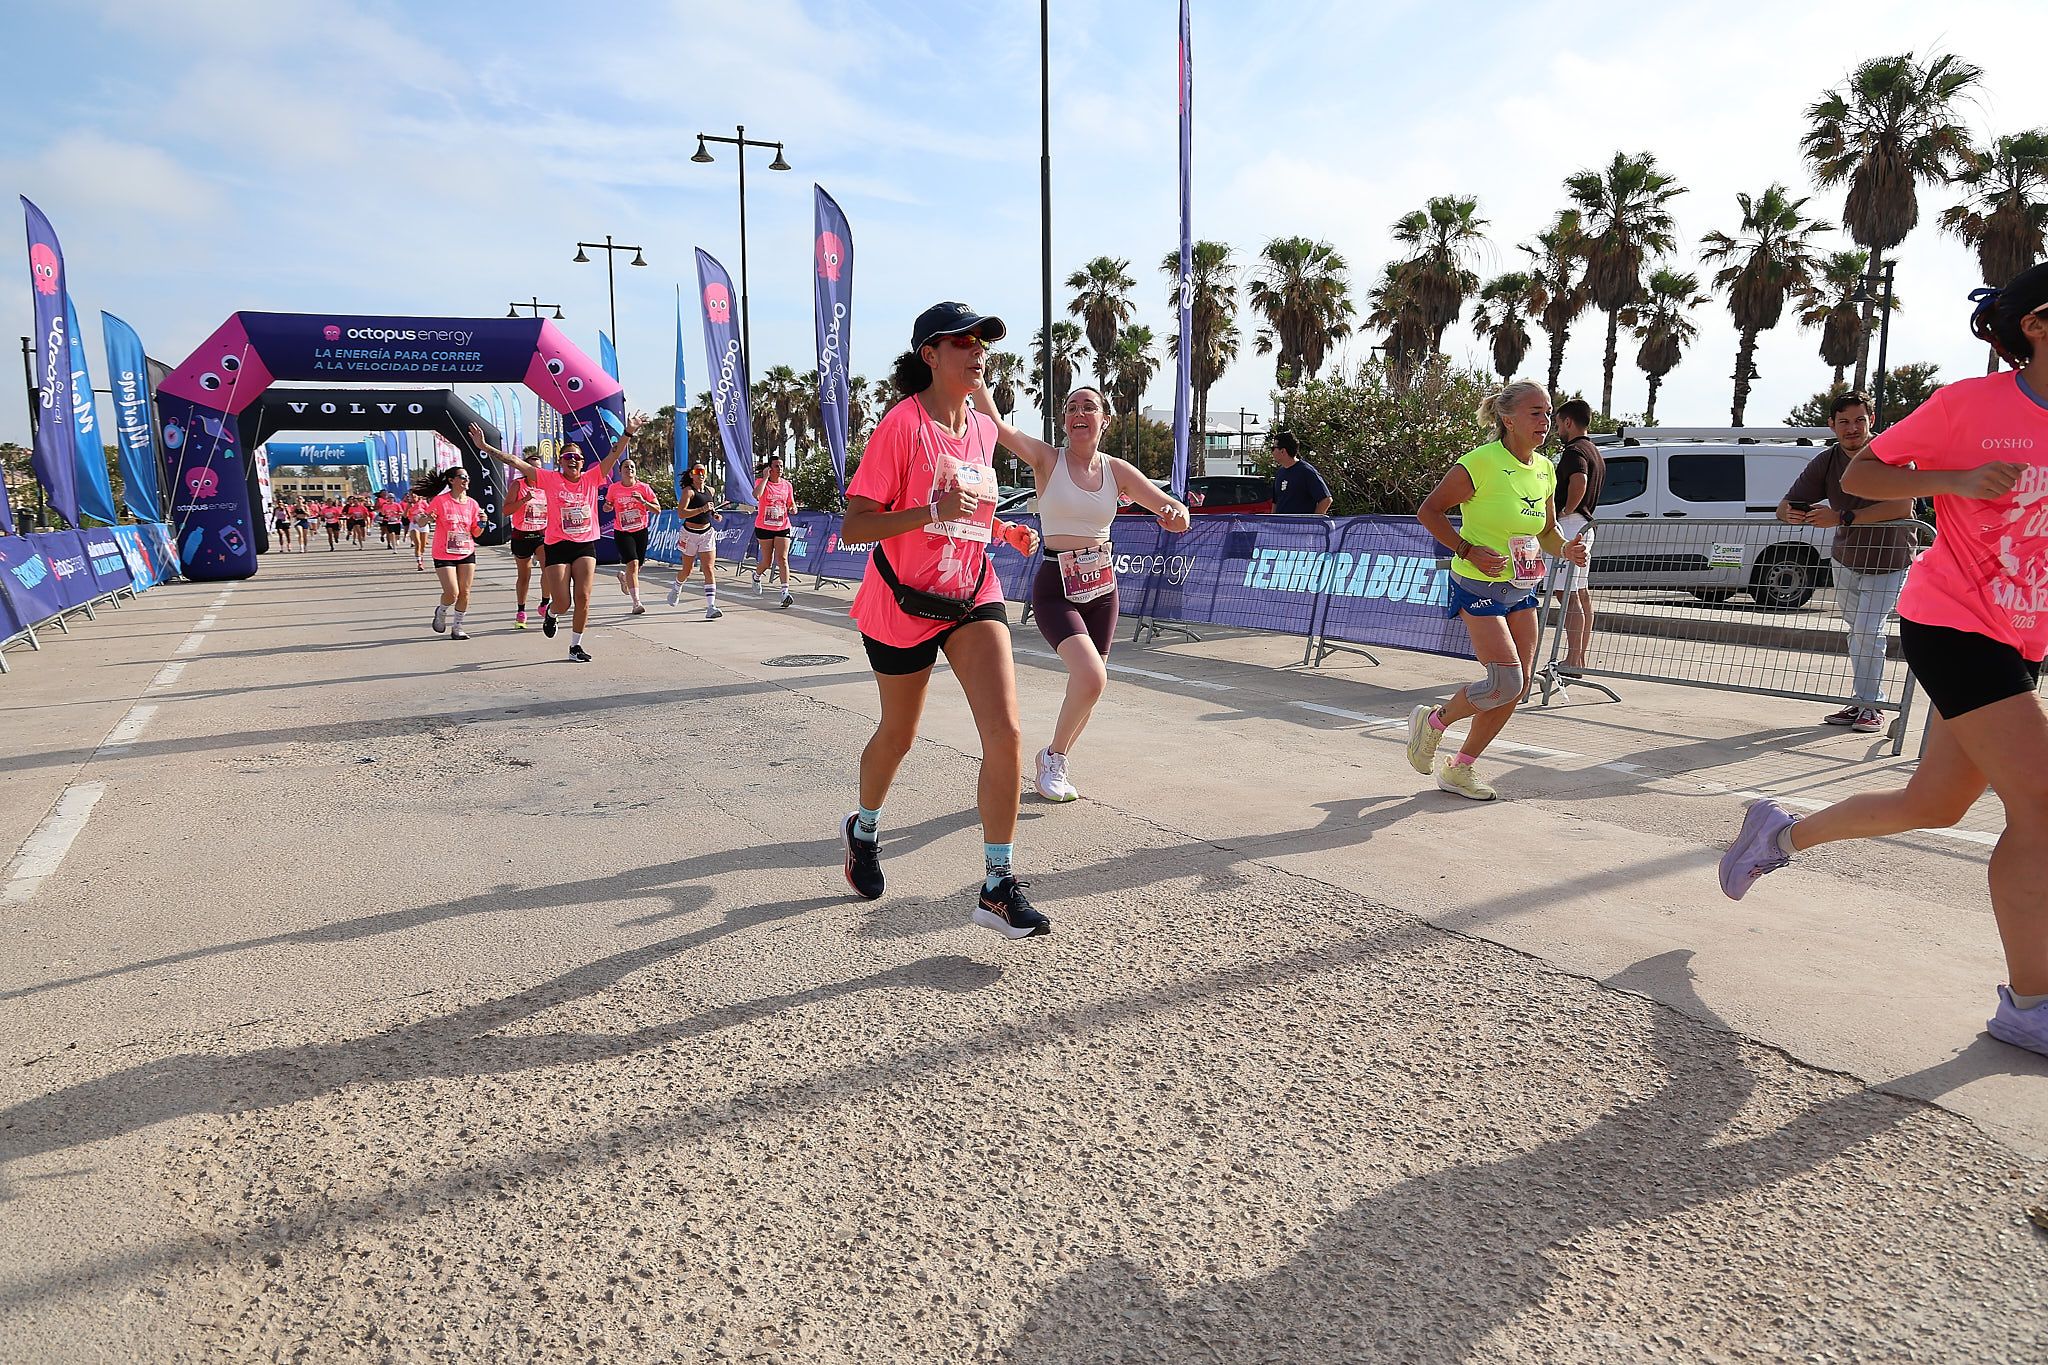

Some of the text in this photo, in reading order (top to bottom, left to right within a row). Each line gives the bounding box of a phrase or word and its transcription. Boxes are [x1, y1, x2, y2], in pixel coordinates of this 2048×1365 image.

[347, 327, 473, 346] octopus energy
[314, 348, 481, 361] LA ENERGÍA PARA CORRER
[314, 361, 484, 372] A LA VELOCIDAD DE LA LUZ
[287, 402, 423, 414] VOLVO
[1982, 438, 2034, 450] OYSHO
[480, 449, 497, 533] VOLVO
[934, 522, 959, 533] OYHO
[1081, 569, 1101, 583] 016
[1130, 555, 1196, 585] energy
